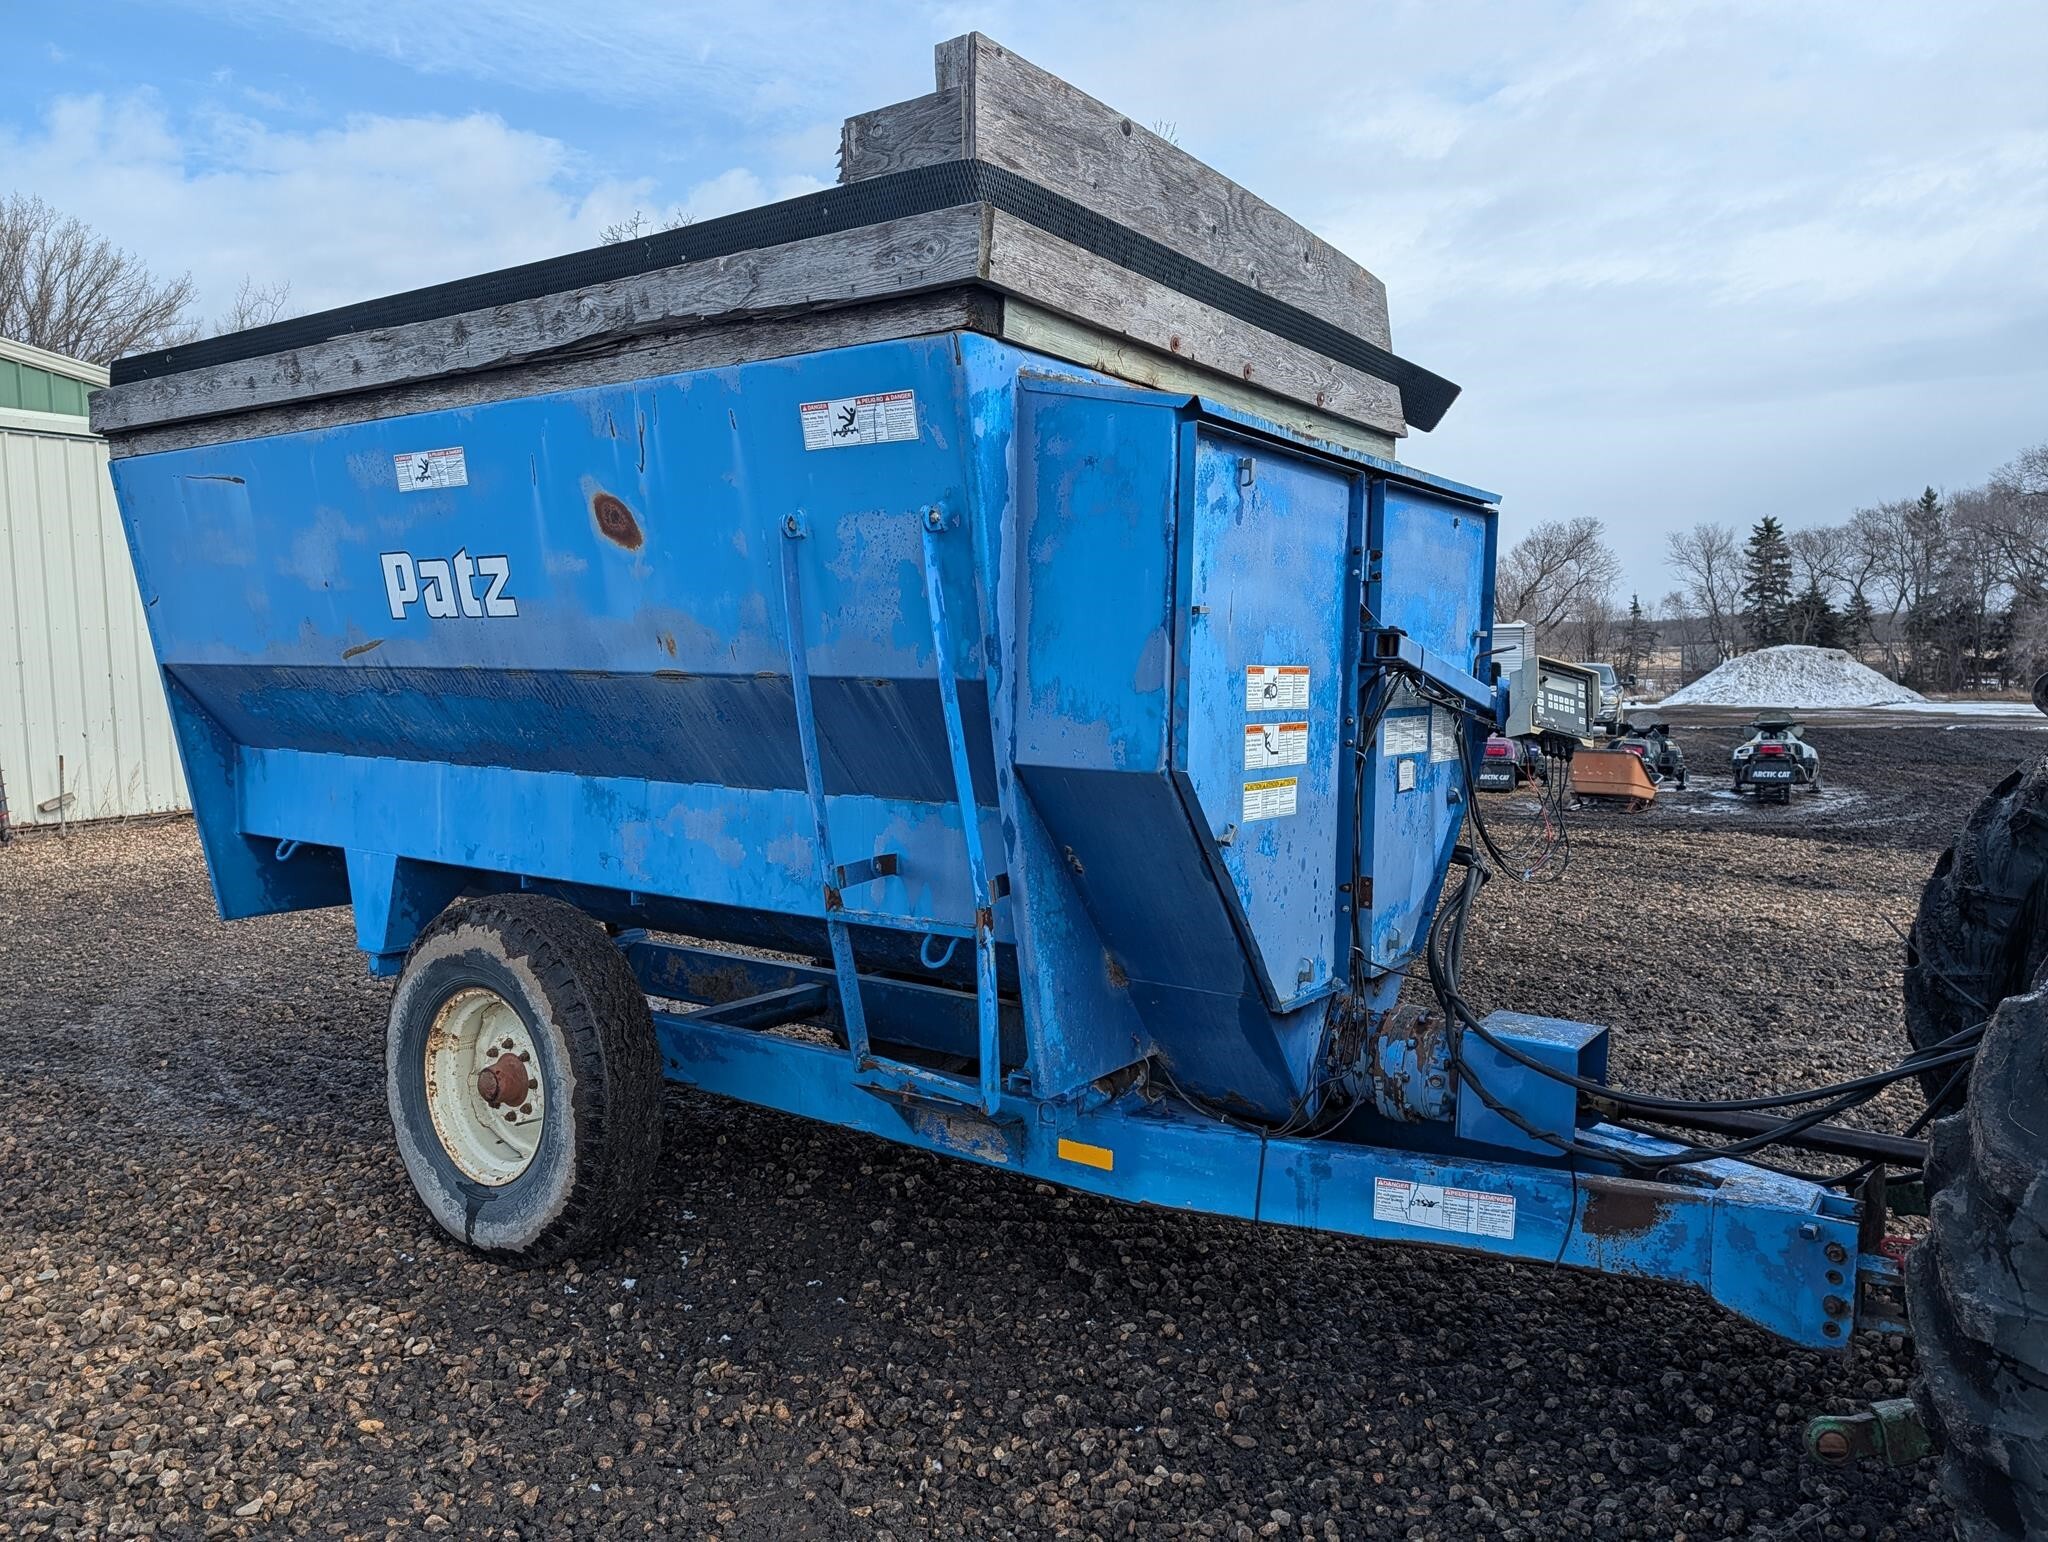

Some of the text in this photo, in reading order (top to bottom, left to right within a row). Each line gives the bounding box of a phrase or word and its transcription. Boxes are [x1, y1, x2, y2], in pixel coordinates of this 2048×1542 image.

[890, 392, 912, 401] DANGER
[807, 402, 828, 411] DANGER
[379, 547, 519, 620] Patz
[1752, 770, 1791, 778] ARCTIC CAT
[1383, 1180, 1409, 1189] DANGER
[1485, 1194, 1513, 1204] DANGER
